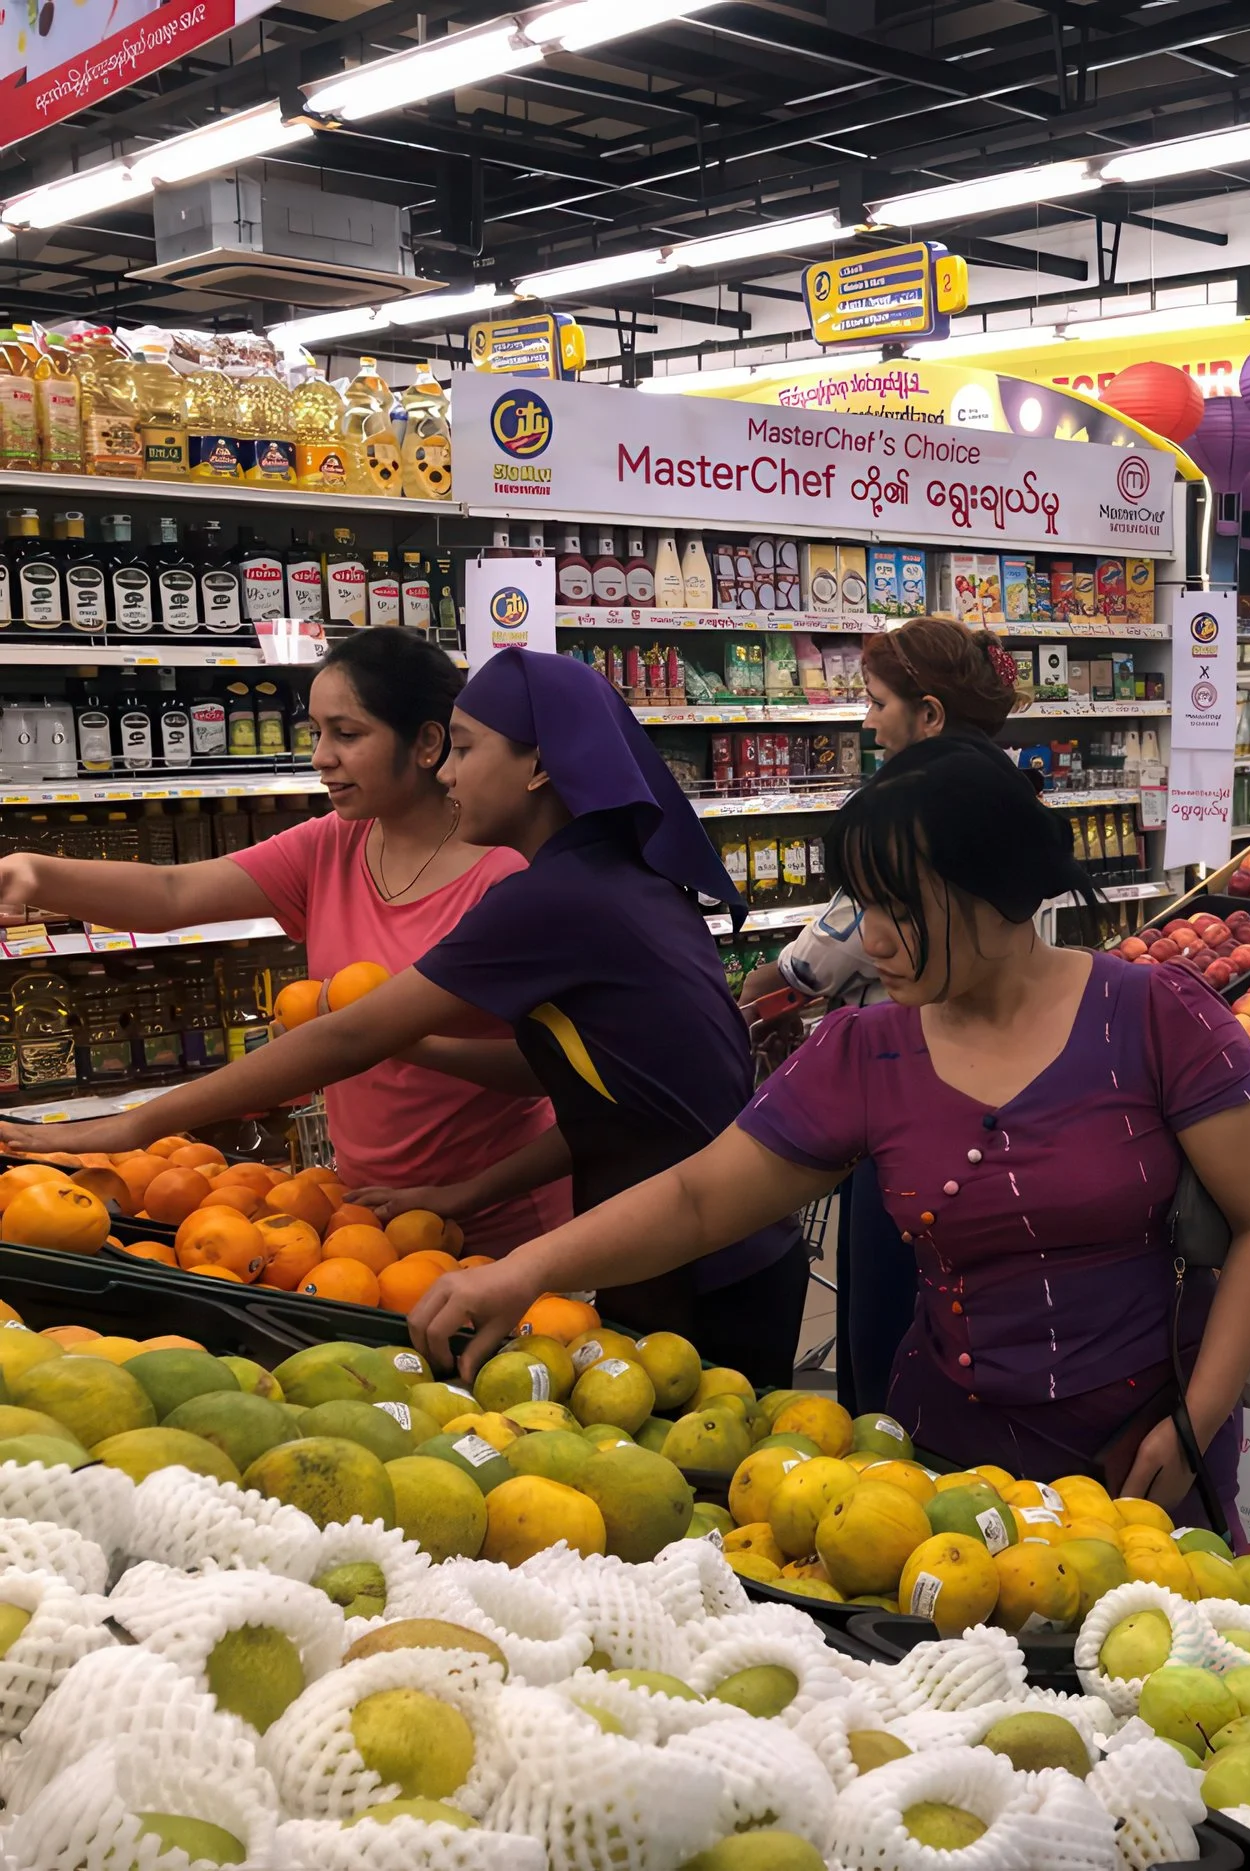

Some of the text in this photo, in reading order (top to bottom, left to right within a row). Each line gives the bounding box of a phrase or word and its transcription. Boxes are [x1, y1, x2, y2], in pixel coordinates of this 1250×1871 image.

[748, 418, 981, 464] MasterChef's Choice
[618, 443, 836, 498] MasterChef
